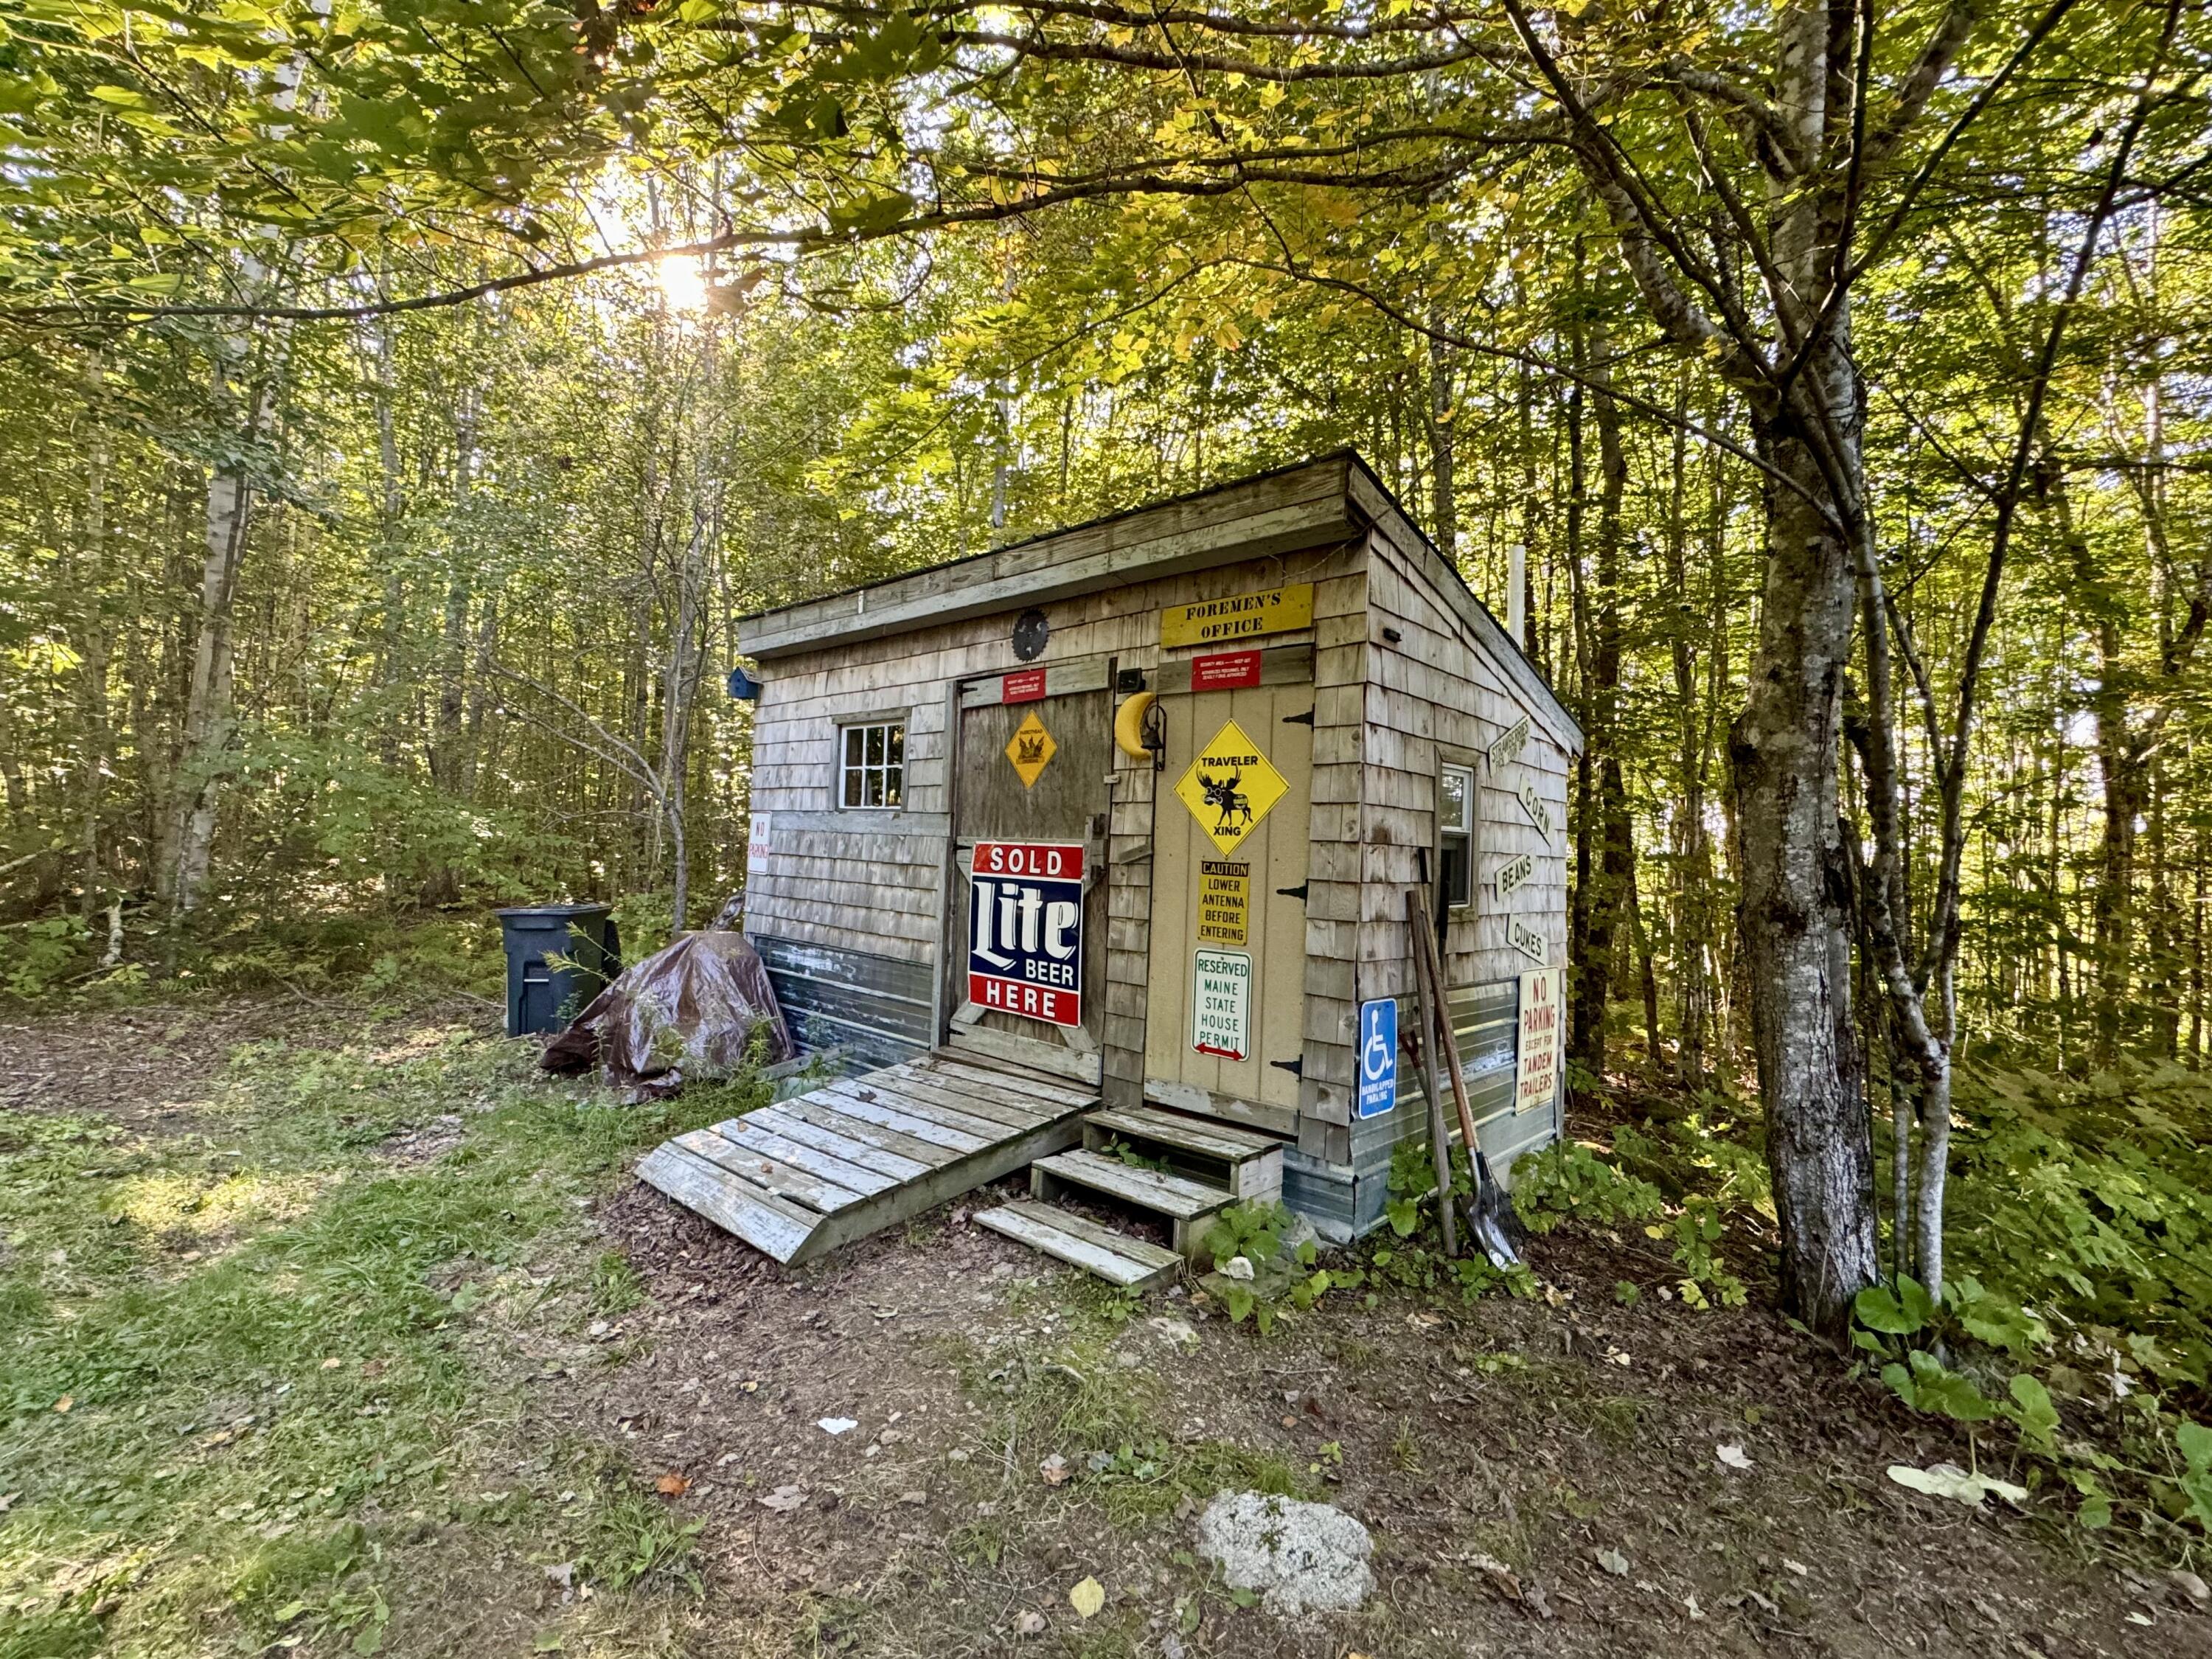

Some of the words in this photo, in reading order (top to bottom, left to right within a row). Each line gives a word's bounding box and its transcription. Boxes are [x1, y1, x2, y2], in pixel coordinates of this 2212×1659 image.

[1186, 592, 1281, 621] FOREMEN'S
[1201, 617, 1263, 639] OFFICE
[1492, 719, 1528, 763] STRAWBERRIES
[1202, 756, 1258, 767] TRAVELER
[1526, 787, 1551, 835] CORN
[756, 821, 765, 836] NO
[1213, 827, 1241, 836] XING
[990, 846, 1062, 875] SOLD
[1203, 863, 1248, 876] CAUTION
[1502, 855, 1532, 893] BEANS
[1208, 878, 1240, 892] LOWER
[1202, 894, 1244, 908] ANTENNA
[971, 881, 1079, 971] Lite
[1205, 910, 1241, 924] BEFORE
[1200, 925, 1244, 941] ENTERING
[1514, 922, 1542, 957] CUKES
[1026, 959, 1074, 987] BEER
[1197, 959, 1248, 977] RESERVED
[1204, 978, 1238, 995] MAINE
[1533, 976, 1547, 1003] NO
[986, 980, 1056, 1018] HERE
[1205, 997, 1236, 1014] STATE
[1201, 1014, 1239, 1032] HOUSE
[1524, 1004, 1555, 1035] PARKING
[1199, 1031, 1240, 1050] PERMIT
[1525, 1037, 1543, 1051] EXCEPT
[1544, 1034, 1552, 1046] FOR
[1523, 1051, 1553, 1076] TANDEM
[1361, 1078, 1394, 1096] HANDICAPPED
[1520, 1072, 1552, 1100] TRAILERS
[1366, 1091, 1388, 1105] PARKING
